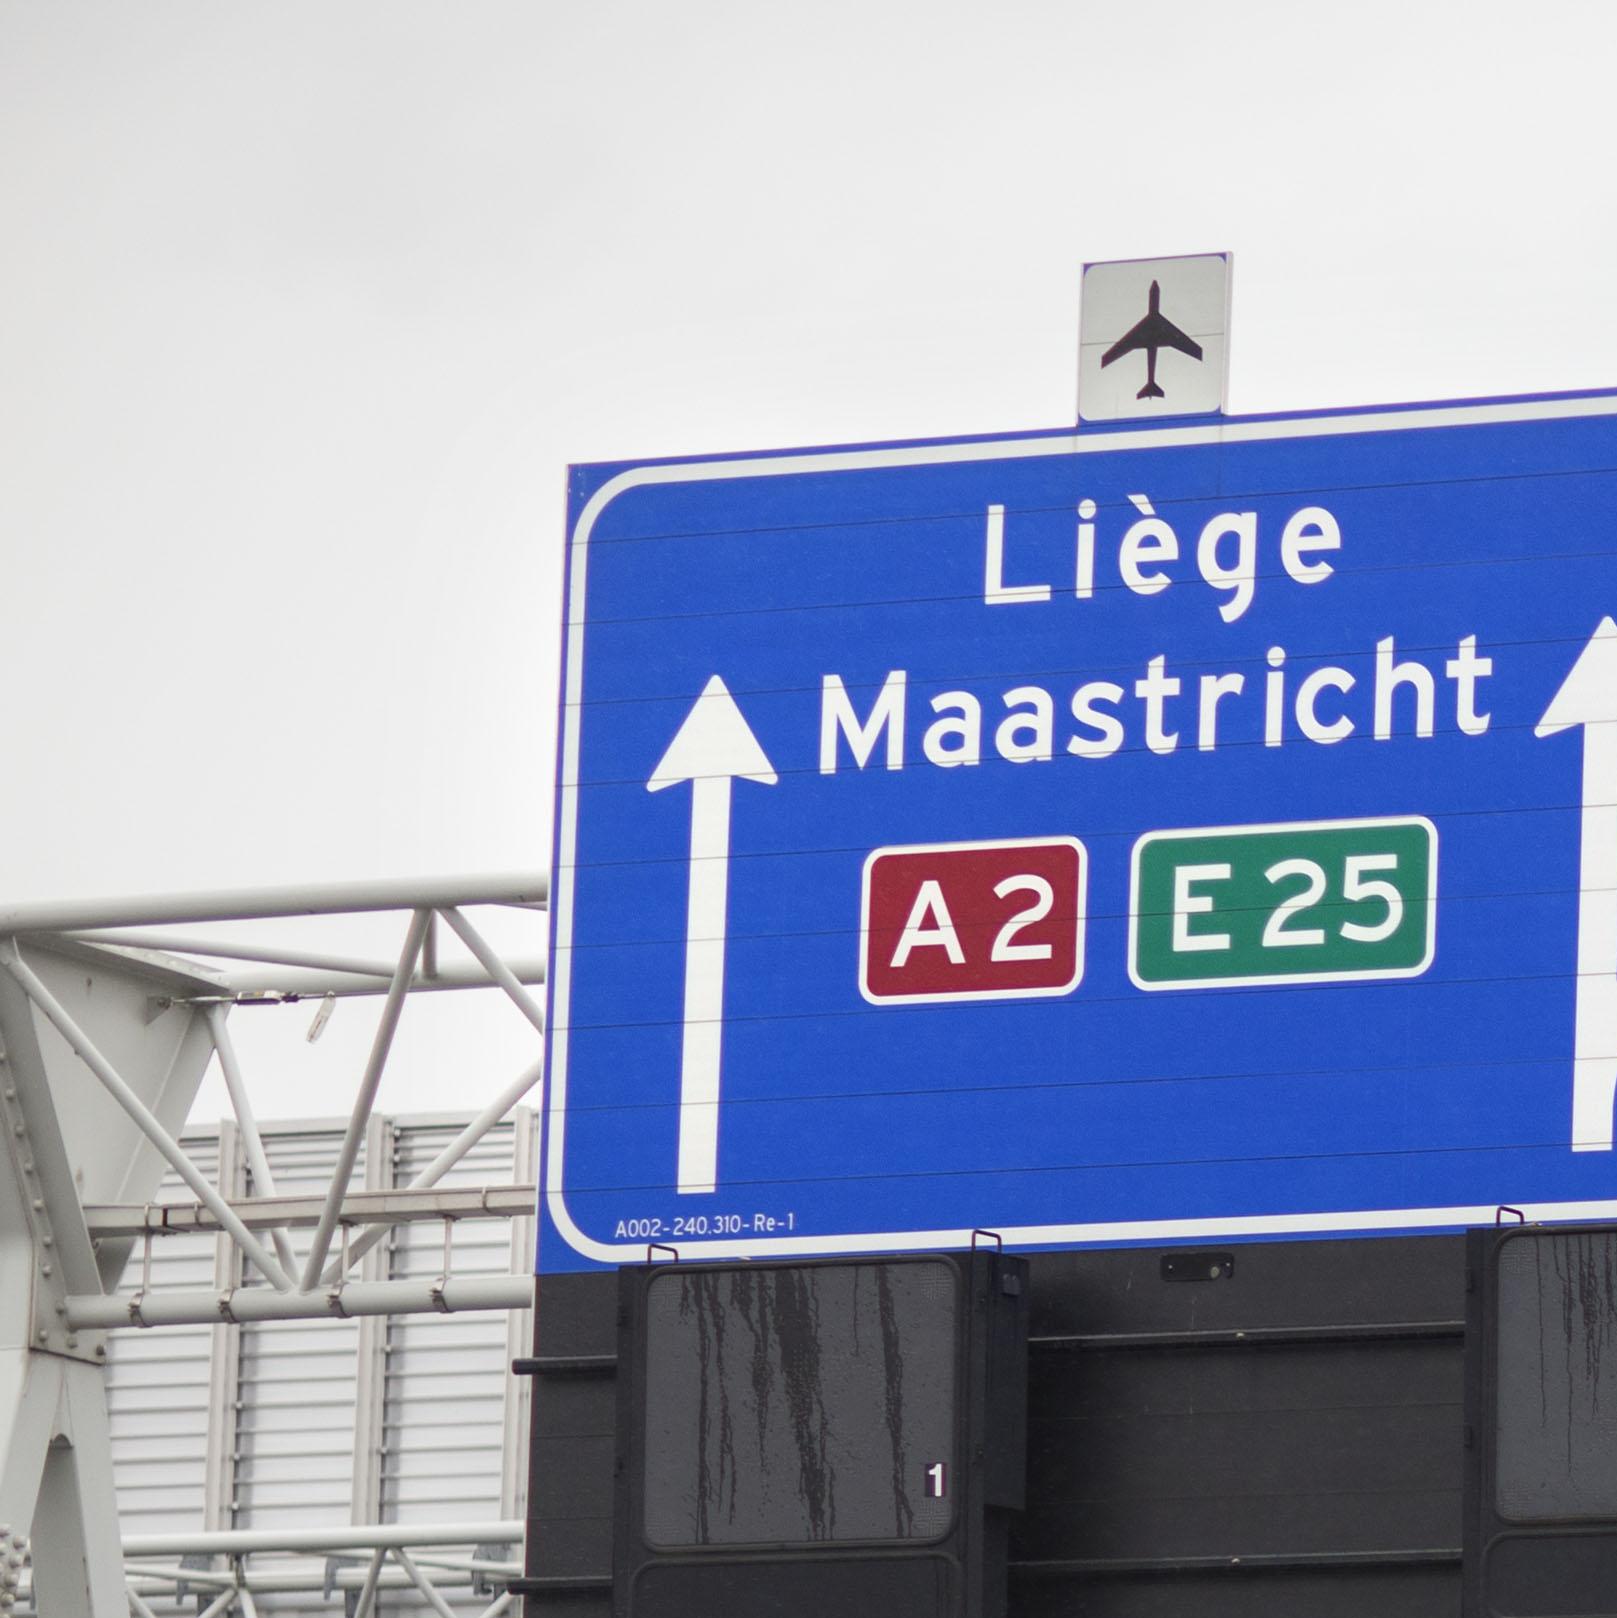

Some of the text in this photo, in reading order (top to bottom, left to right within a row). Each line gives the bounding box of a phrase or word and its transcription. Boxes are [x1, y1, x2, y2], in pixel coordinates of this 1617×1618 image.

[984, 494, 1341, 623] Liège
[819, 634, 1493, 775] Maastricht
[928, 1463, 942, 1497] 1
